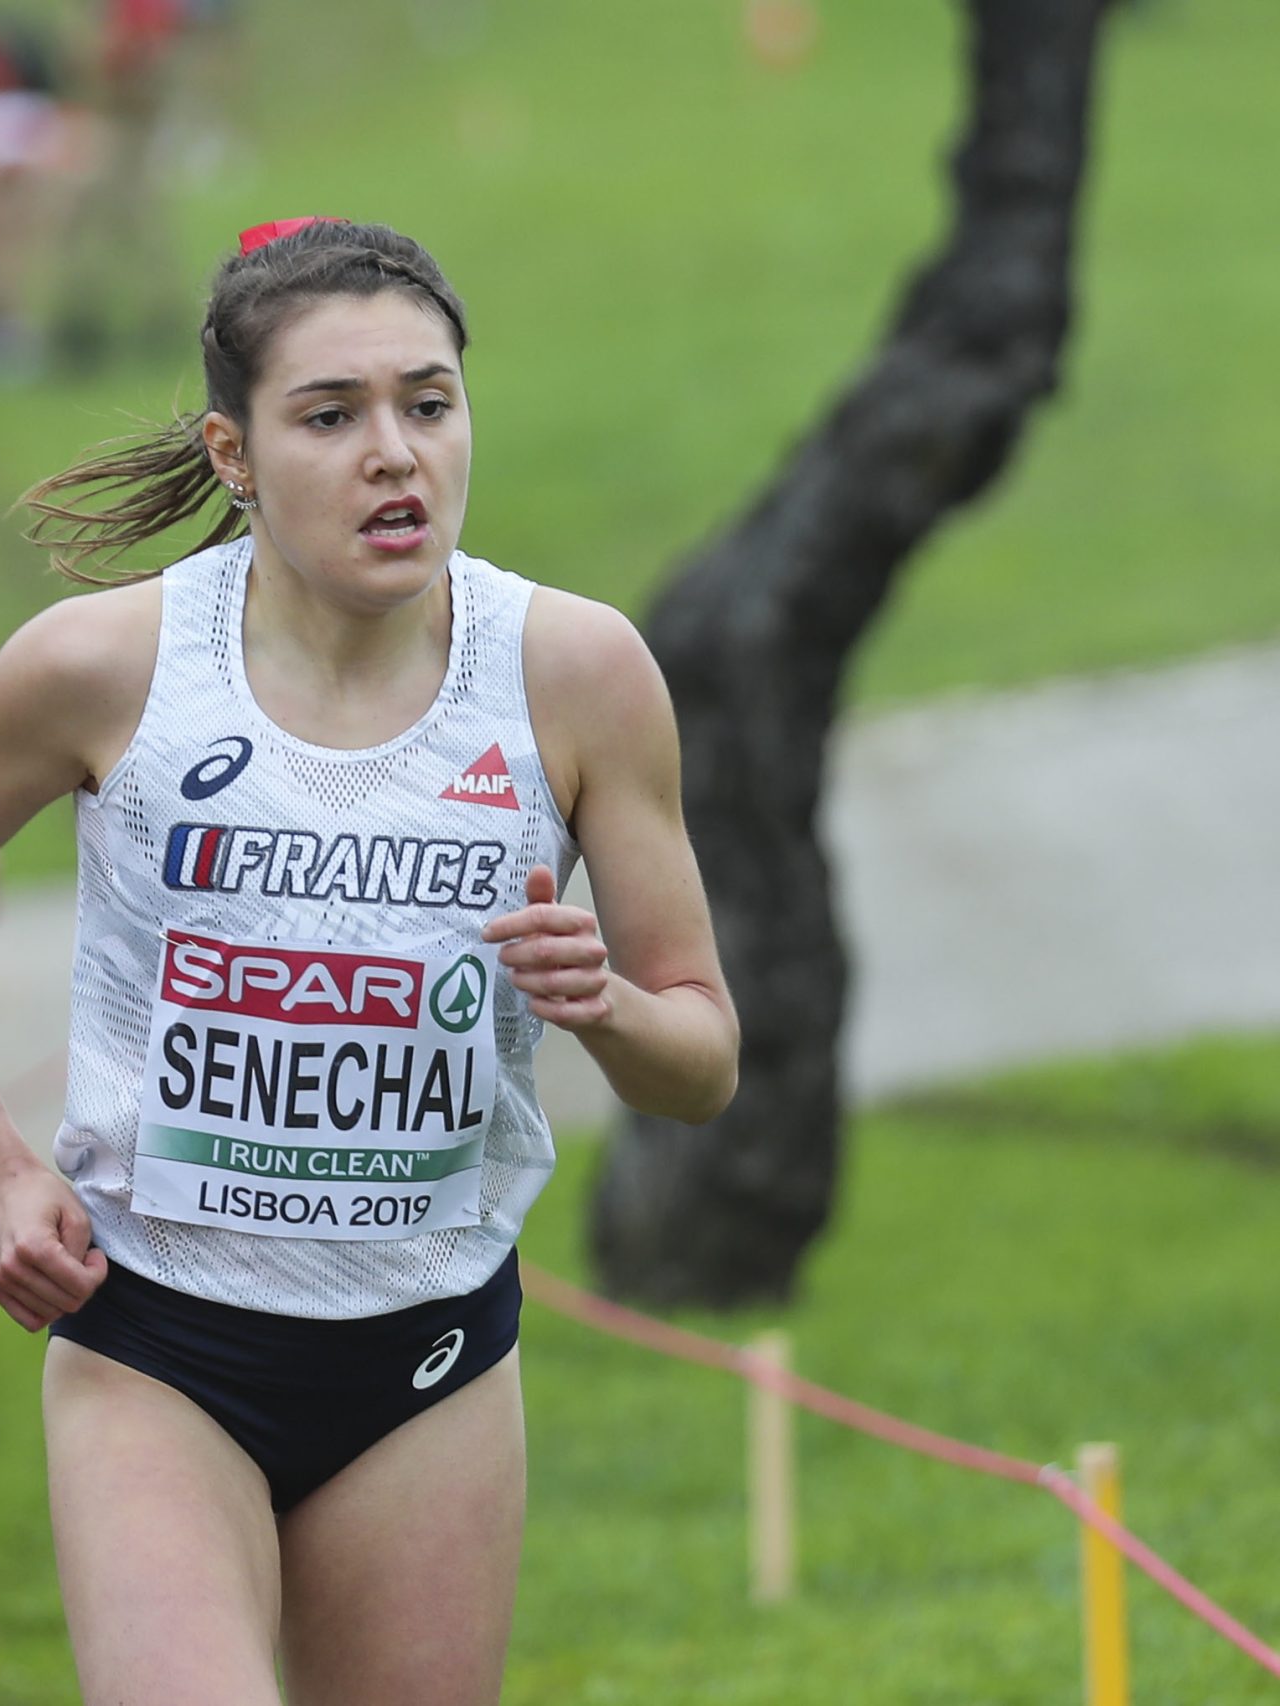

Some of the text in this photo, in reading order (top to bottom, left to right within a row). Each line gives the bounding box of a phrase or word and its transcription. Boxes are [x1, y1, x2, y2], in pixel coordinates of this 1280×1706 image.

[453, 772, 512, 795] MAIF
[217, 825, 506, 909] FRANCE
[169, 941, 415, 1018] SPAR
[159, 1022, 484, 1133] SENECHAL
[211, 1139, 220, 1164] I
[230, 1143, 297, 1175] RUN
[198, 1181, 432, 1227] LISBOA 2019
